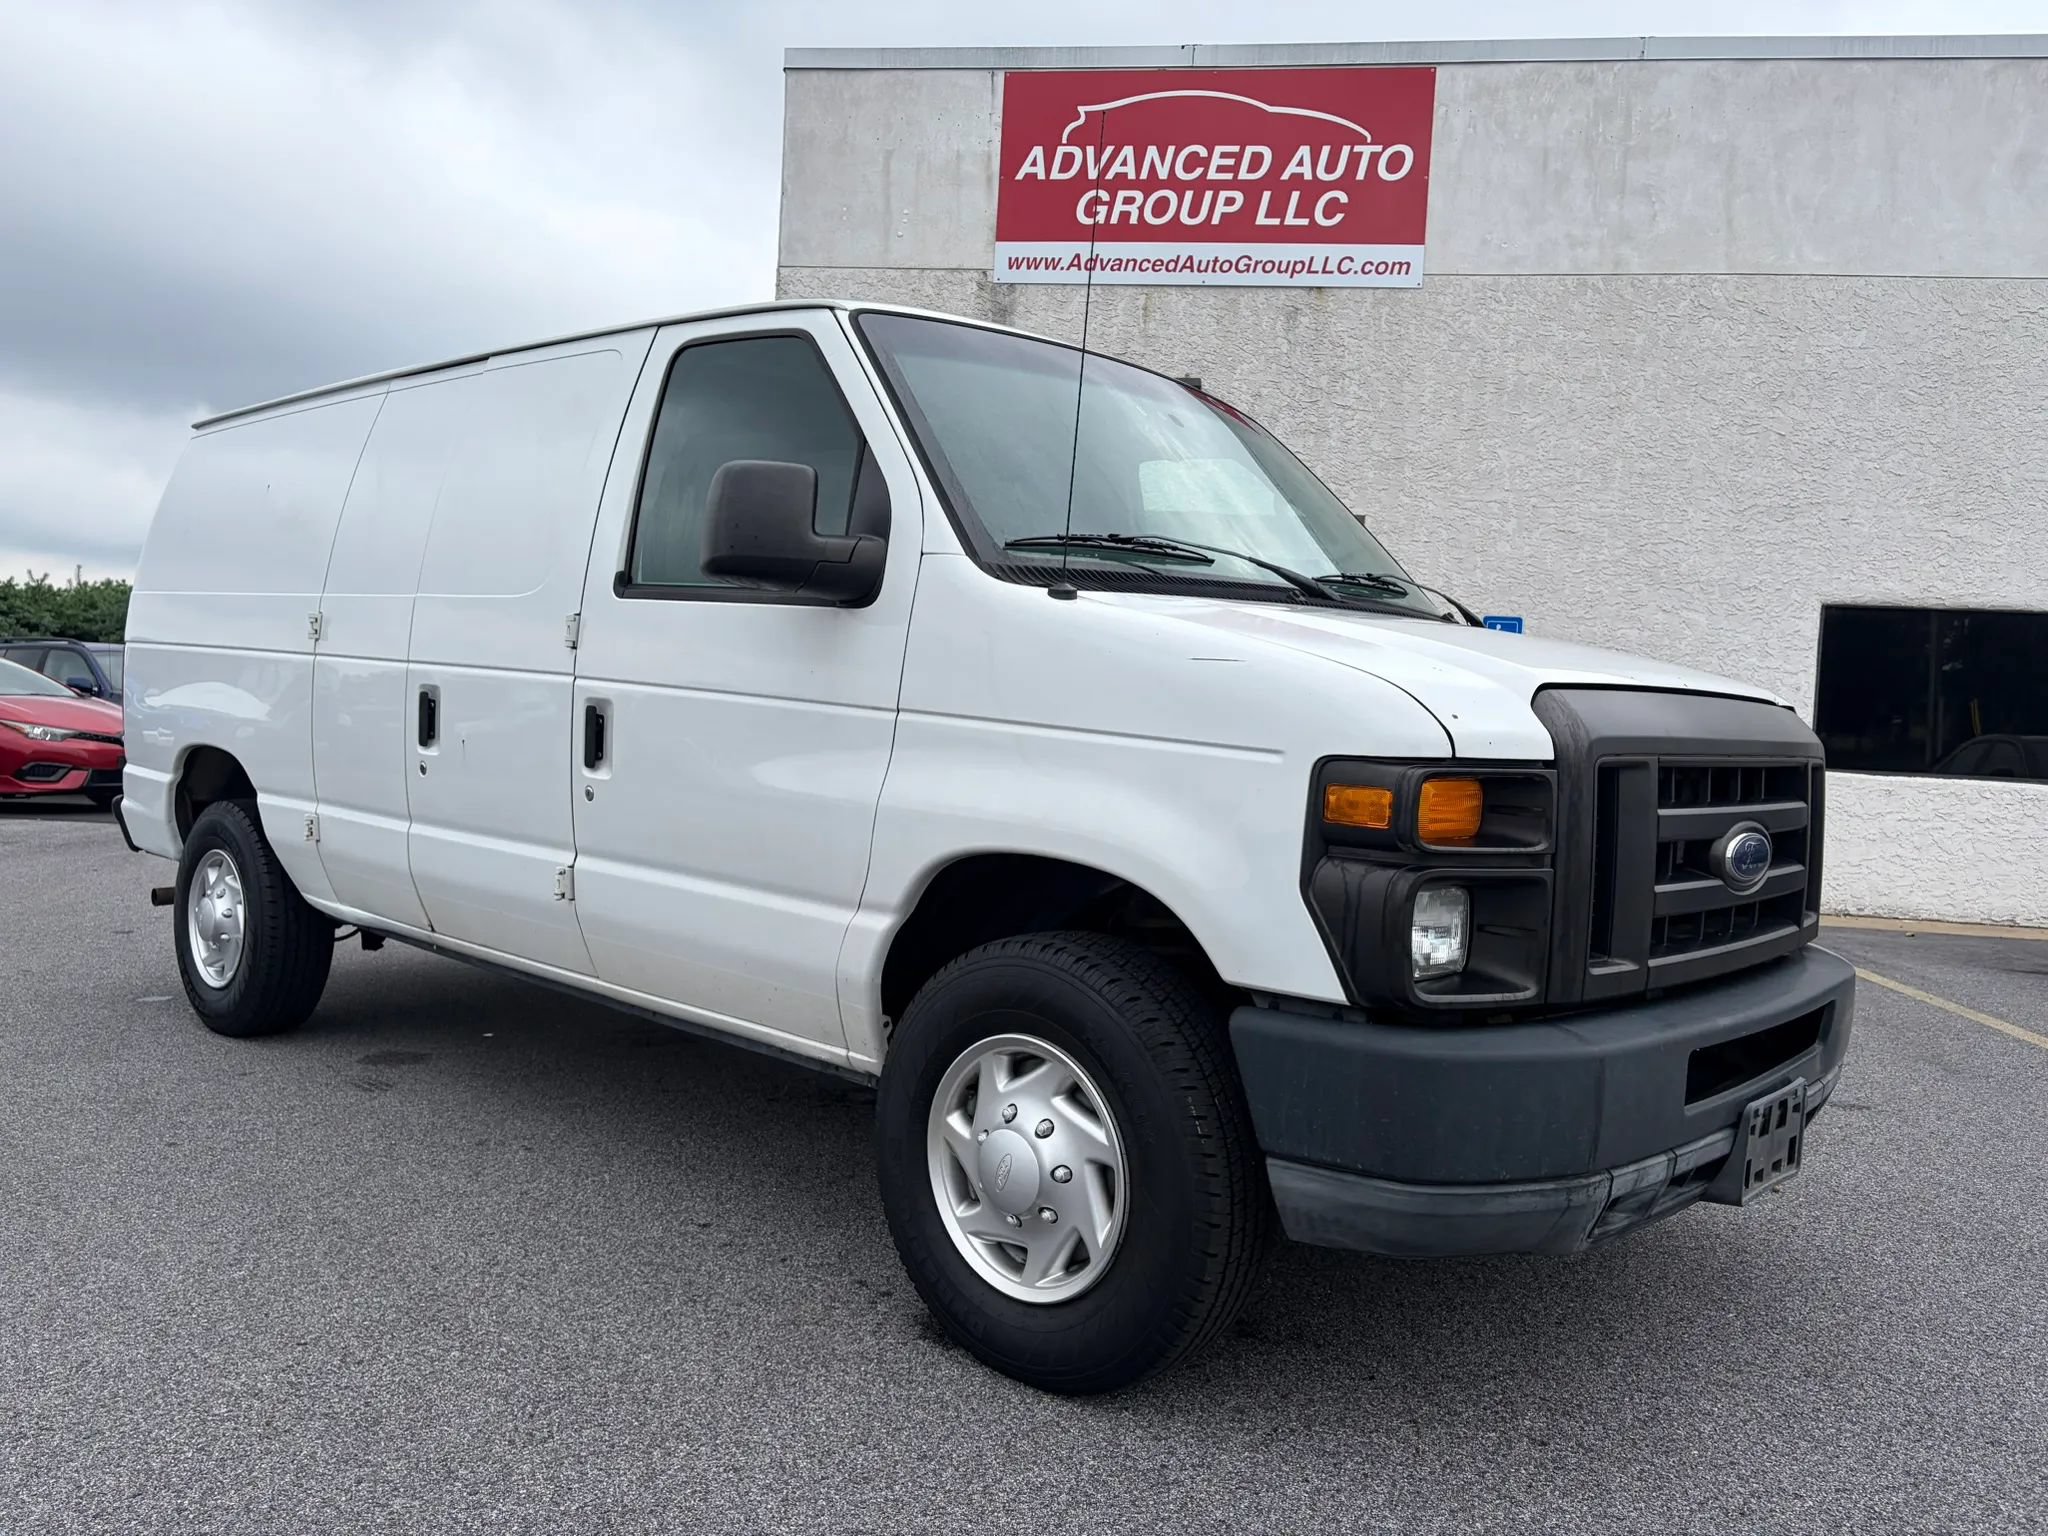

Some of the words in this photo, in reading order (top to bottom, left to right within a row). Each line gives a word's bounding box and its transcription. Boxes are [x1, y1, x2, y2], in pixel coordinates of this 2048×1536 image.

[1014, 145, 1272, 181] ADVANCED
[1280, 144, 1414, 181] AUTO
[1076, 190, 1244, 226] GROUP
[1254, 190, 1349, 227] LLC
[1007, 253, 1411, 279] www.AdvancedAutoGroupLLC.com
